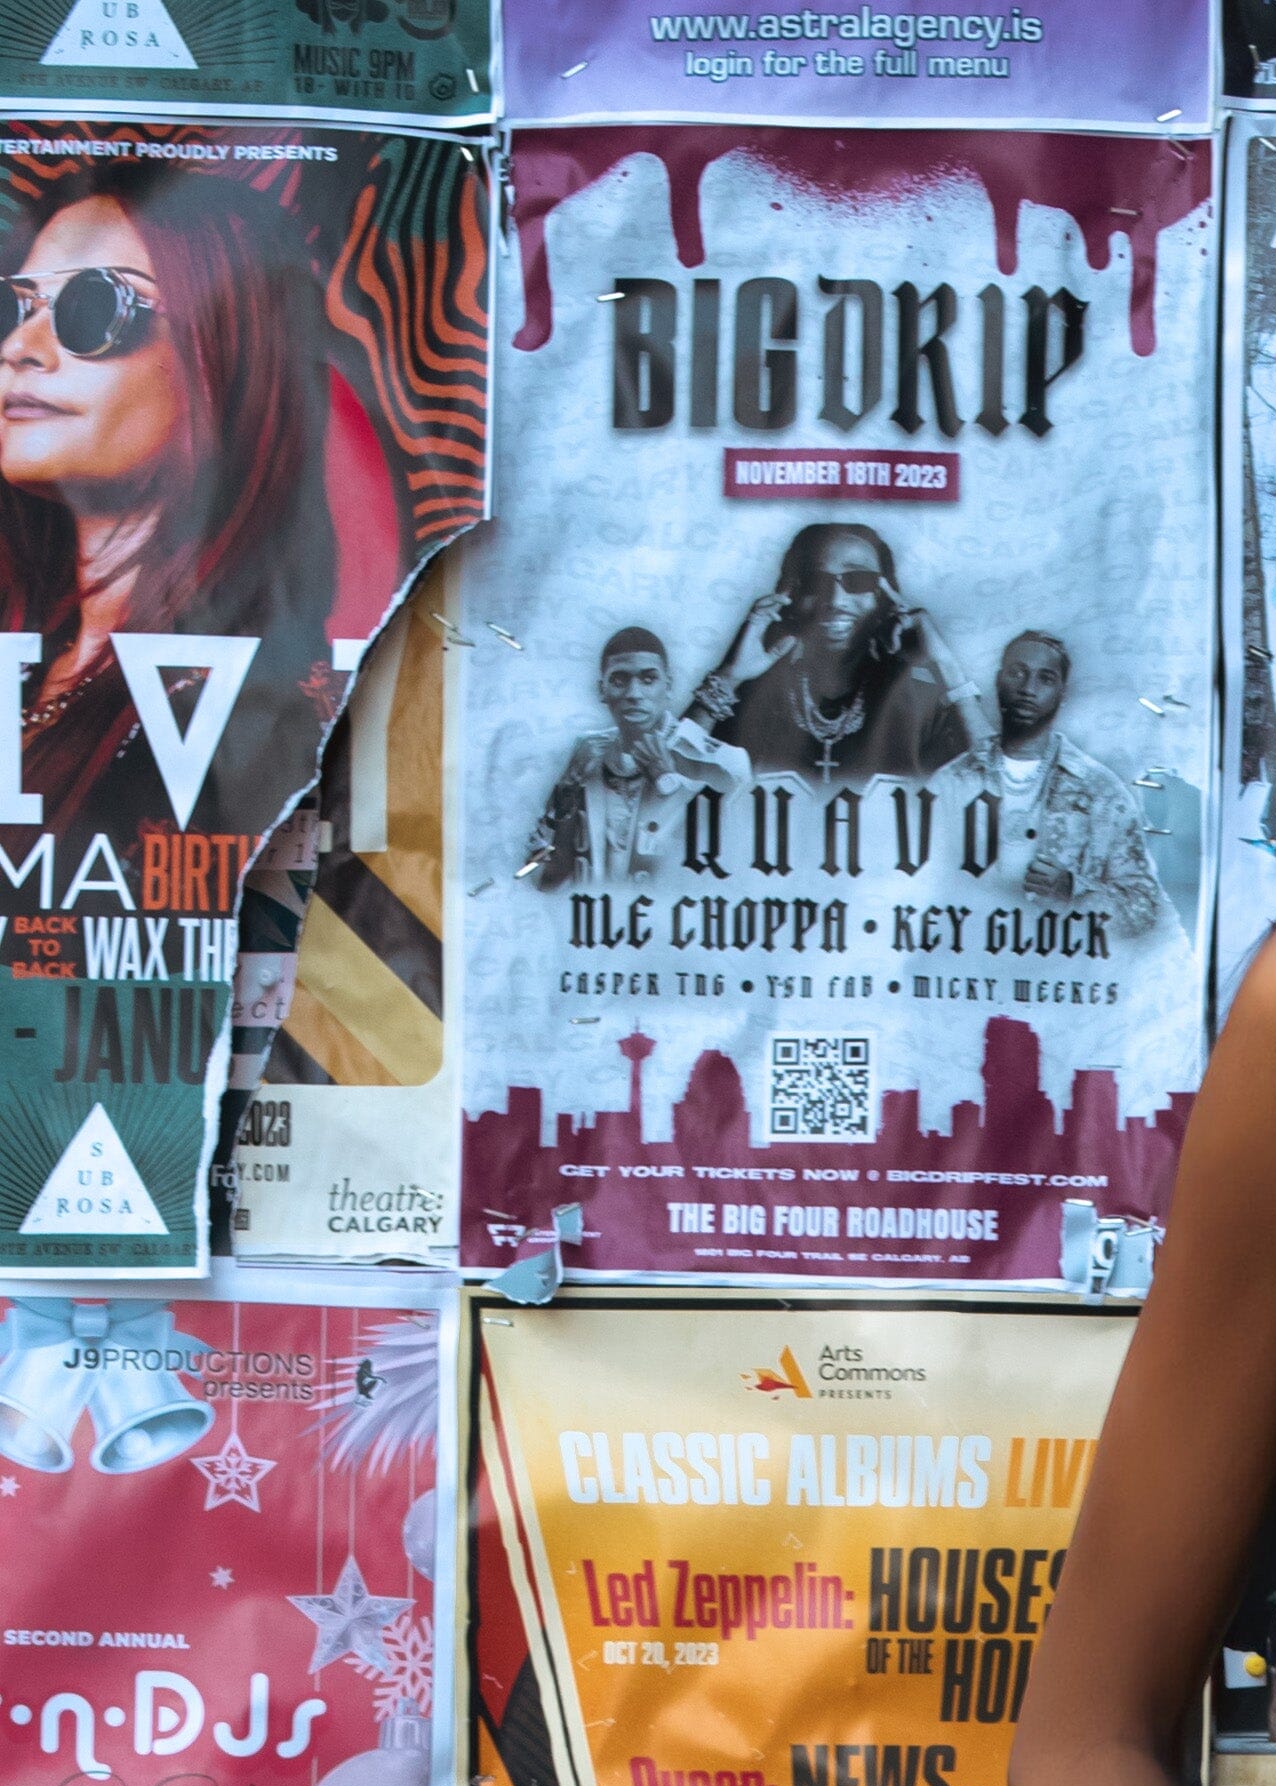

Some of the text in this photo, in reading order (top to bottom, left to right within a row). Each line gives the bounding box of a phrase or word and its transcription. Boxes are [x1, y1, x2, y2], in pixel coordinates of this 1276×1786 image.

[81, 28, 160, 48] ROSA
[651, 6, 1042, 47] www.astralagency.is
[686, 51, 1010, 82] login for the full menu
[136, 142, 337, 163] PROUDLY PRESENTS
[735, 460, 947, 489] NOVEMBER 18TH 2023
[682, 786, 999, 876] QUAVO
[569, 894, 1112, 959] NLE CHOPPA KEY GLOCK
[86, 918, 168, 980] WAX
[692, 1166, 1108, 1188] TICKETS NOW BIGDRIPFEST.COM
[328, 1217, 441, 1235] CALGARY
[668, 1202, 998, 1241] THE BIG FOUR ROADHOUSE
[64, 1347, 313, 1376] J9PRODUCTIONS
[819, 1344, 863, 1362] Arts
[819, 1364, 926, 1382] Commons
[202, 1377, 312, 1401] presents
[819, 1389, 892, 1401] PRESENTS
[559, 1431, 991, 1509] CLASSIC ALBUMS
[582, 1559, 855, 1641] Led Zeppelin:
